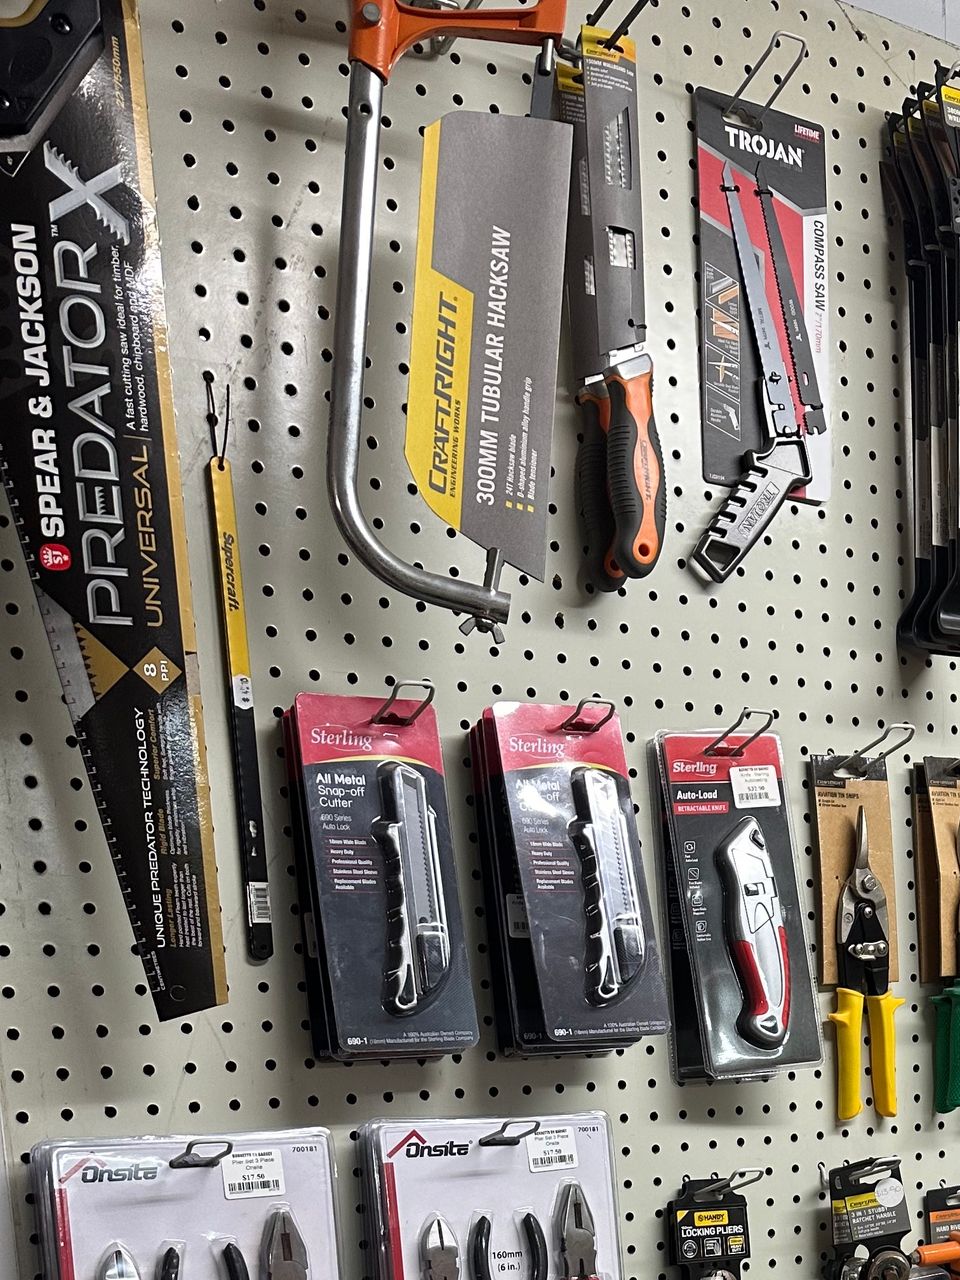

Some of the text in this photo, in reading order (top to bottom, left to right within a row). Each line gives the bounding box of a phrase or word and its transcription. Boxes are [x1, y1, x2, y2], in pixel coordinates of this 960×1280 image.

[724, 125, 804, 168] TROJAN
[812, 219, 826, 312] COMPASS SAW
[110, 244, 136, 431] A fast cutting saw ideal for timber,
[130, 314, 149, 432] hardwood, chipboard
[476, 226, 512, 506] 300MM TUBULAR HACKSAW
[11, 223, 64, 538] SPEAR & JACKSON
[53, 240, 133, 627] PREDATOR
[449, 400, 461, 498] ENGINEERING WORKS
[124, 444, 166, 628] UNIVERSAL
[143, 662, 157, 677] 8
[160, 660, 170, 682] PPI
[311, 727, 373, 752] Sterling
[508, 736, 566, 759] Sterling
[672, 761, 717, 775] Sterling
[315, 772, 366, 786] All Metal
[317, 785, 366, 799] Snap-off
[676, 789, 718, 801] Auto-Load
[319, 797, 353, 808] Cutter
[677, 805, 711, 813] RETRACTABLE
[134, 707, 166, 948] UNIQUE PREDATOR TECHNOLOGY
[347, 1036, 368, 1046] 690-1
[554, 1027, 573, 1037] 690-1
[291, 1145, 318, 1153] 700181
[405, 1140, 470, 1159] Onsite
[81, 1163, 159, 1184] Onsite
[704, 1213, 725, 1221] HANDY
[876, 1210, 897, 1221] HANDLE
[681, 1225, 744, 1238] LOCKING PLIERS
[492, 1250, 523, 1260] 160mm
